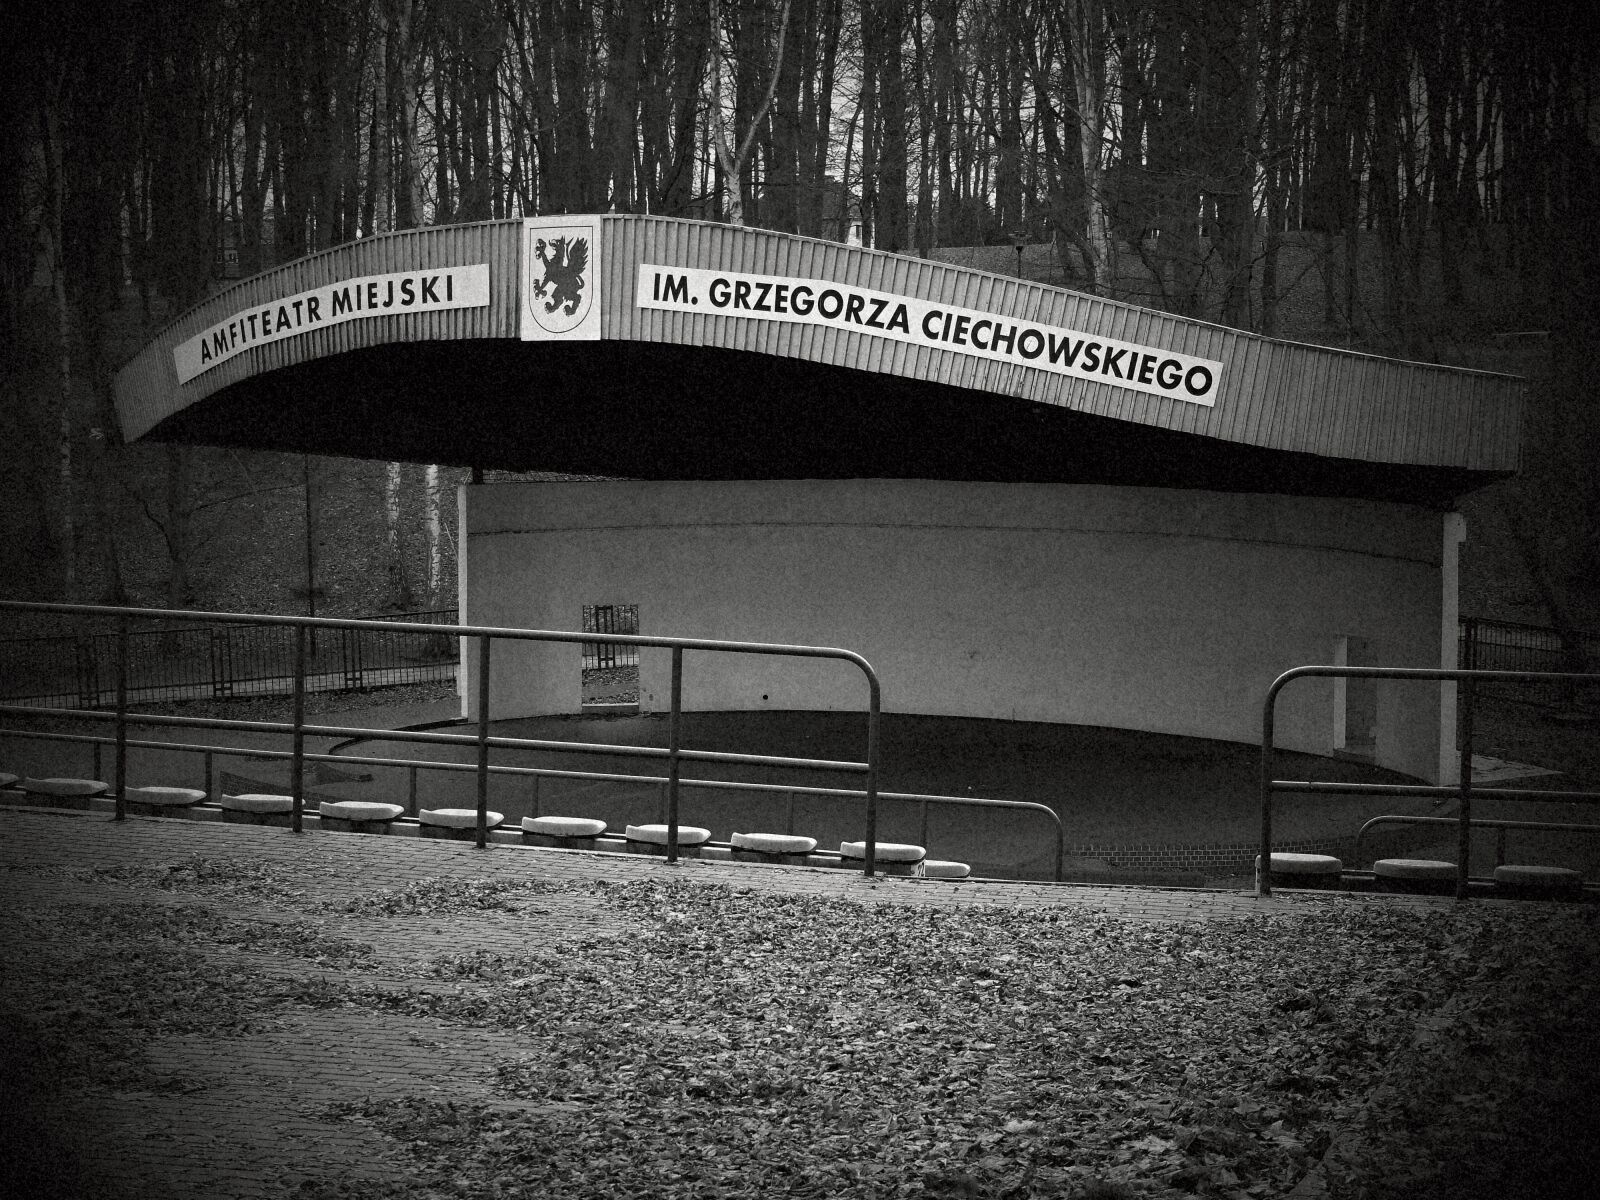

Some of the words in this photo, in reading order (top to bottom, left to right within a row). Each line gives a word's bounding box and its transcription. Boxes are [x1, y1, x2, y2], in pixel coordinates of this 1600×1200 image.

[201, 297, 321, 365] AMFITEATR
[331, 275, 453, 317] MIEJSKI
[653, 273, 698, 306] IM.
[708, 278, 910, 335] GRZEGORZA
[921, 310, 1214, 397] CIECHOWSKIEGO
